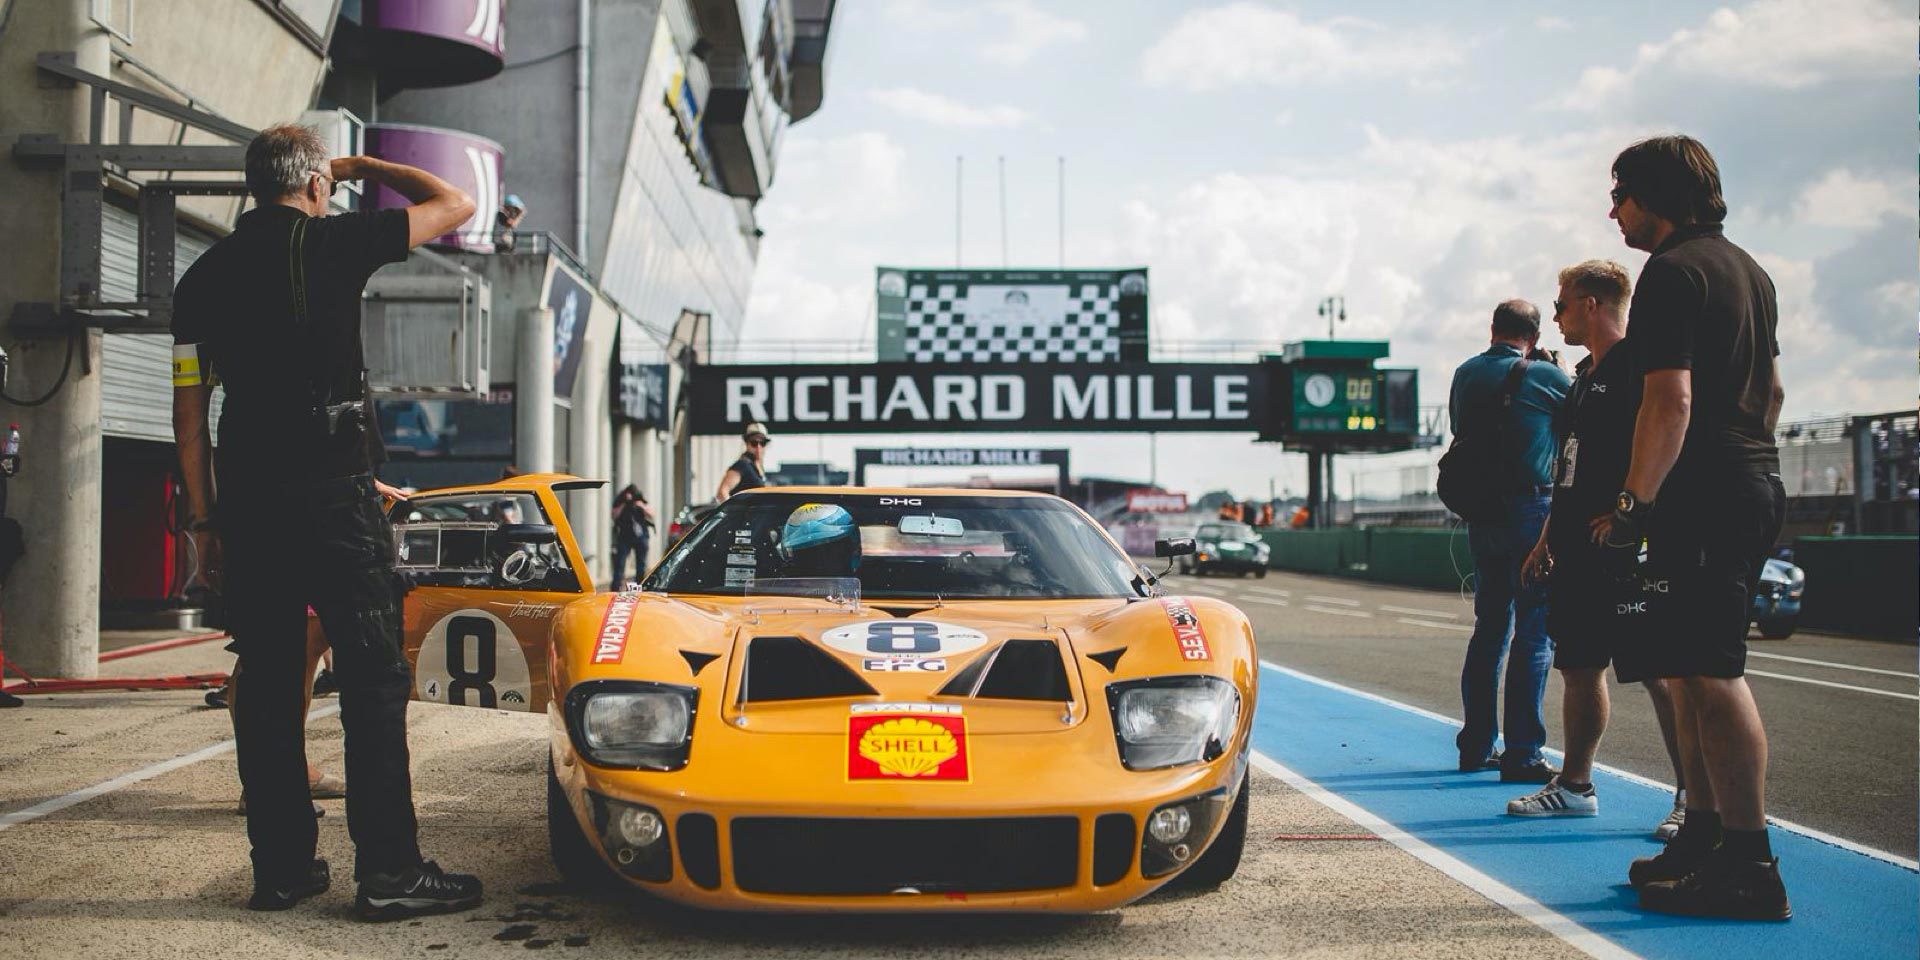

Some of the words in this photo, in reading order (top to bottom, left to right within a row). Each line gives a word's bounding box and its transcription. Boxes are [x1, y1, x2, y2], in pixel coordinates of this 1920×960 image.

[726, 376, 1025, 422] RICHARD
[1053, 375, 1249, 421] MILLE
[882, 450, 975, 465] RICHARD
[979, 450, 1042, 465] MILLE
[880, 498, 921, 506] DHG
[595, 600, 634, 664] MARCHAL
[866, 622, 941, 653] 8
[446, 616, 498, 709] 8
[864, 659, 945, 671] EFG
[428, 682, 437, 697] 4
[871, 739, 946, 753] SHELL
